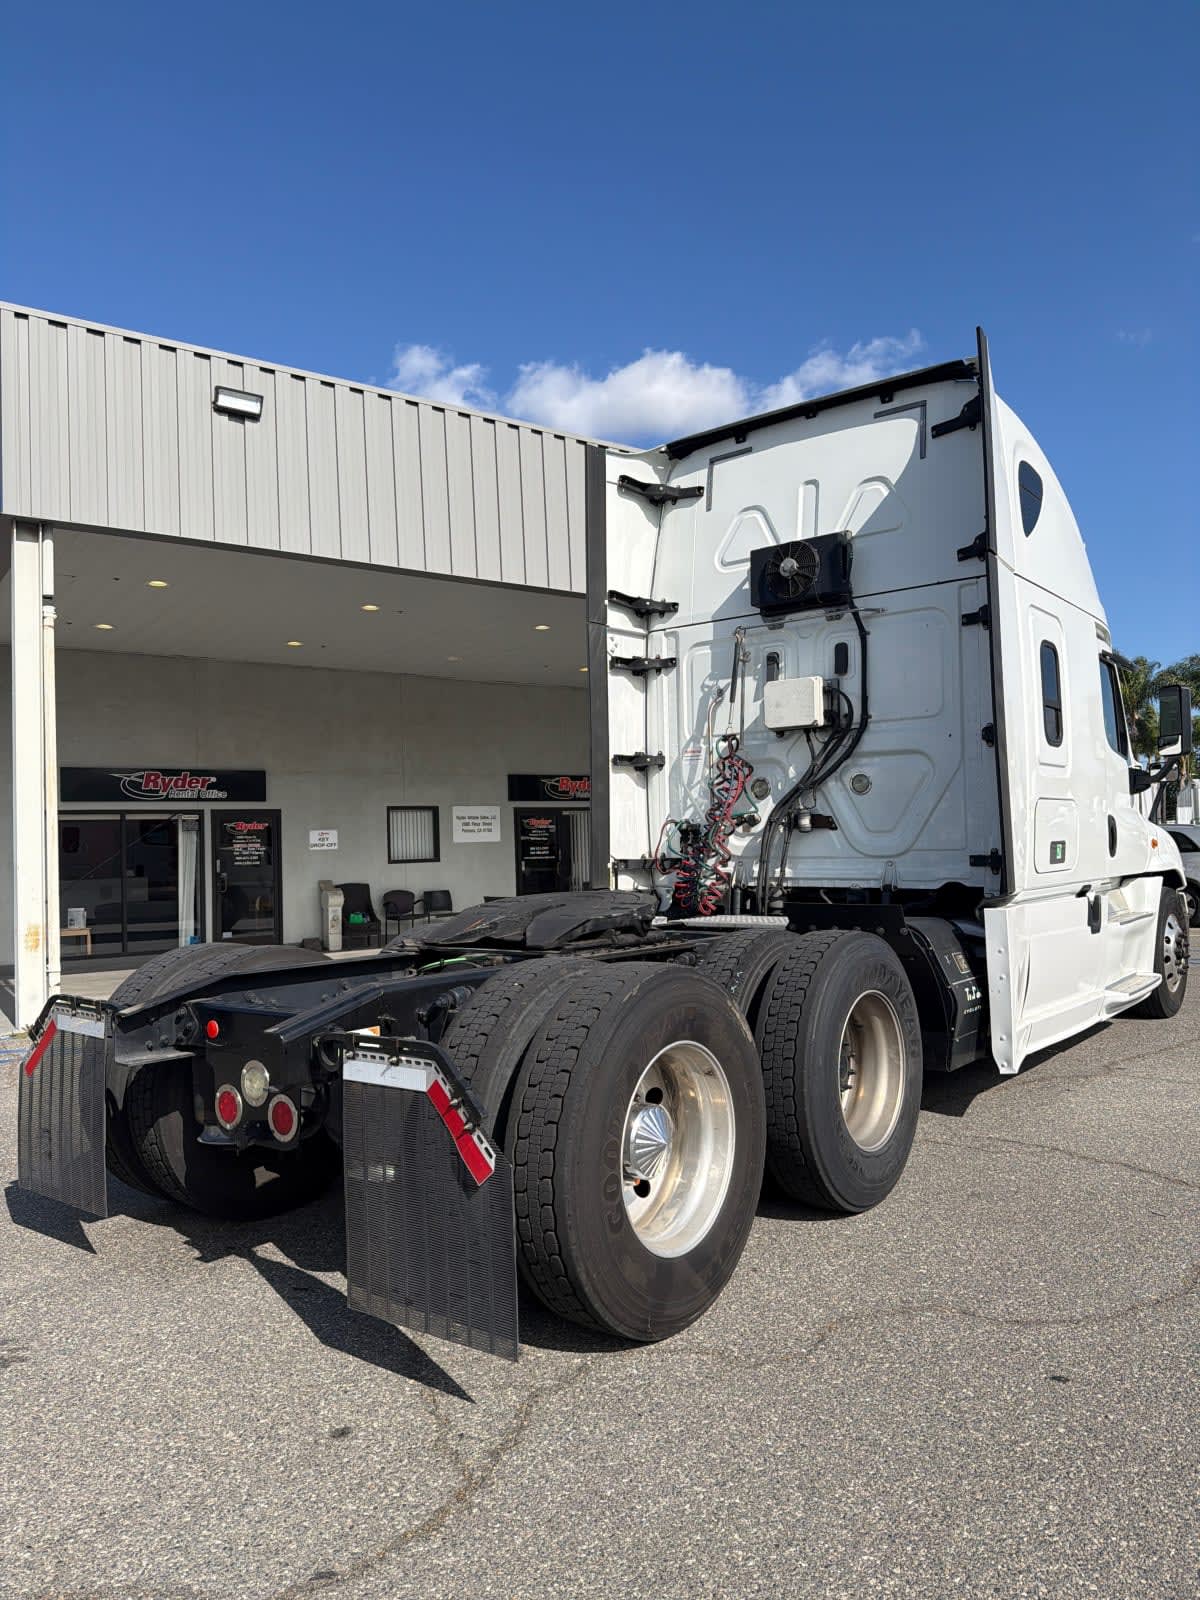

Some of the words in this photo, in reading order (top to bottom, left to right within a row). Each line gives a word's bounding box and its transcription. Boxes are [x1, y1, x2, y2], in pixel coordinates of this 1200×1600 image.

[142, 771, 213, 794] Ryder
[559, 777, 590, 794] Ryd
[168, 789, 198, 799] Rental
[199, 790, 228, 799] Office
[235, 821, 266, 832] Ryder
